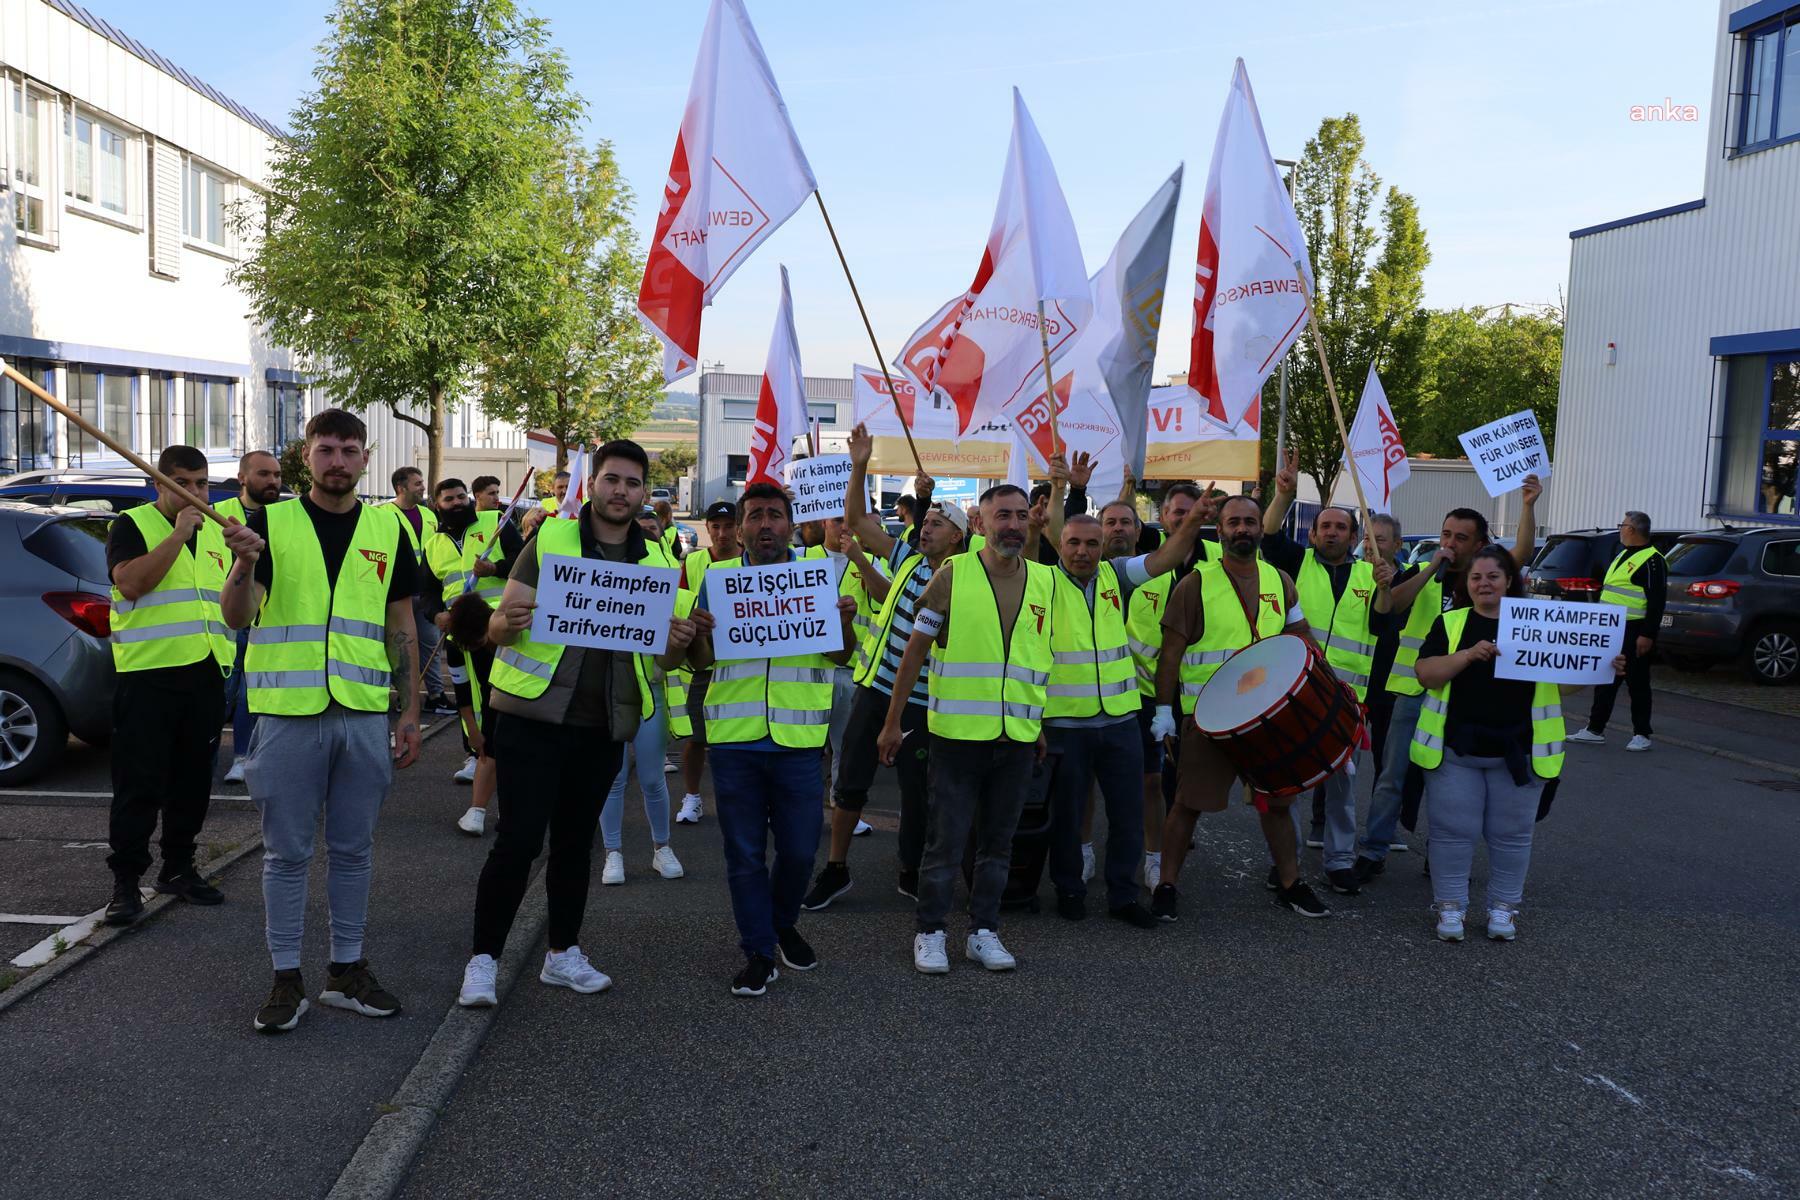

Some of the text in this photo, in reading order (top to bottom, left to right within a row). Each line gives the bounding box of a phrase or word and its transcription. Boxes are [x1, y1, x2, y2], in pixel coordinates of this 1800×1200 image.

[879, 379, 915, 395] NGG
[1469, 417, 1536, 449] WIR KÄMPFEN
[919, 452, 999, 464] GEWERKSCHAFT
[1479, 434, 1540, 465] FÜR UNSERE
[789, 460, 853, 480] Wir kämpfe
[1492, 453, 1542, 482] ZUKUNFT
[799, 483, 815, 496] für
[793, 497, 845, 514] Tarifvert
[368, 552, 388, 562] NGG
[553, 564, 671, 595] Wir kämpfen
[725, 568, 828, 596] BİZ İŞÇİLER
[565, 591, 645, 616] für einen
[733, 595, 816, 619] BİRLİKTE
[1511, 606, 1620, 627] WIR KÄMPFEN
[547, 614, 656, 646] Tarifvertrag
[728, 619, 827, 647] GÜÇLÜYÜZ
[1512, 625, 1610, 648] FÜR UNSERE
[1515, 649, 1602, 671] ZUKUNFT
